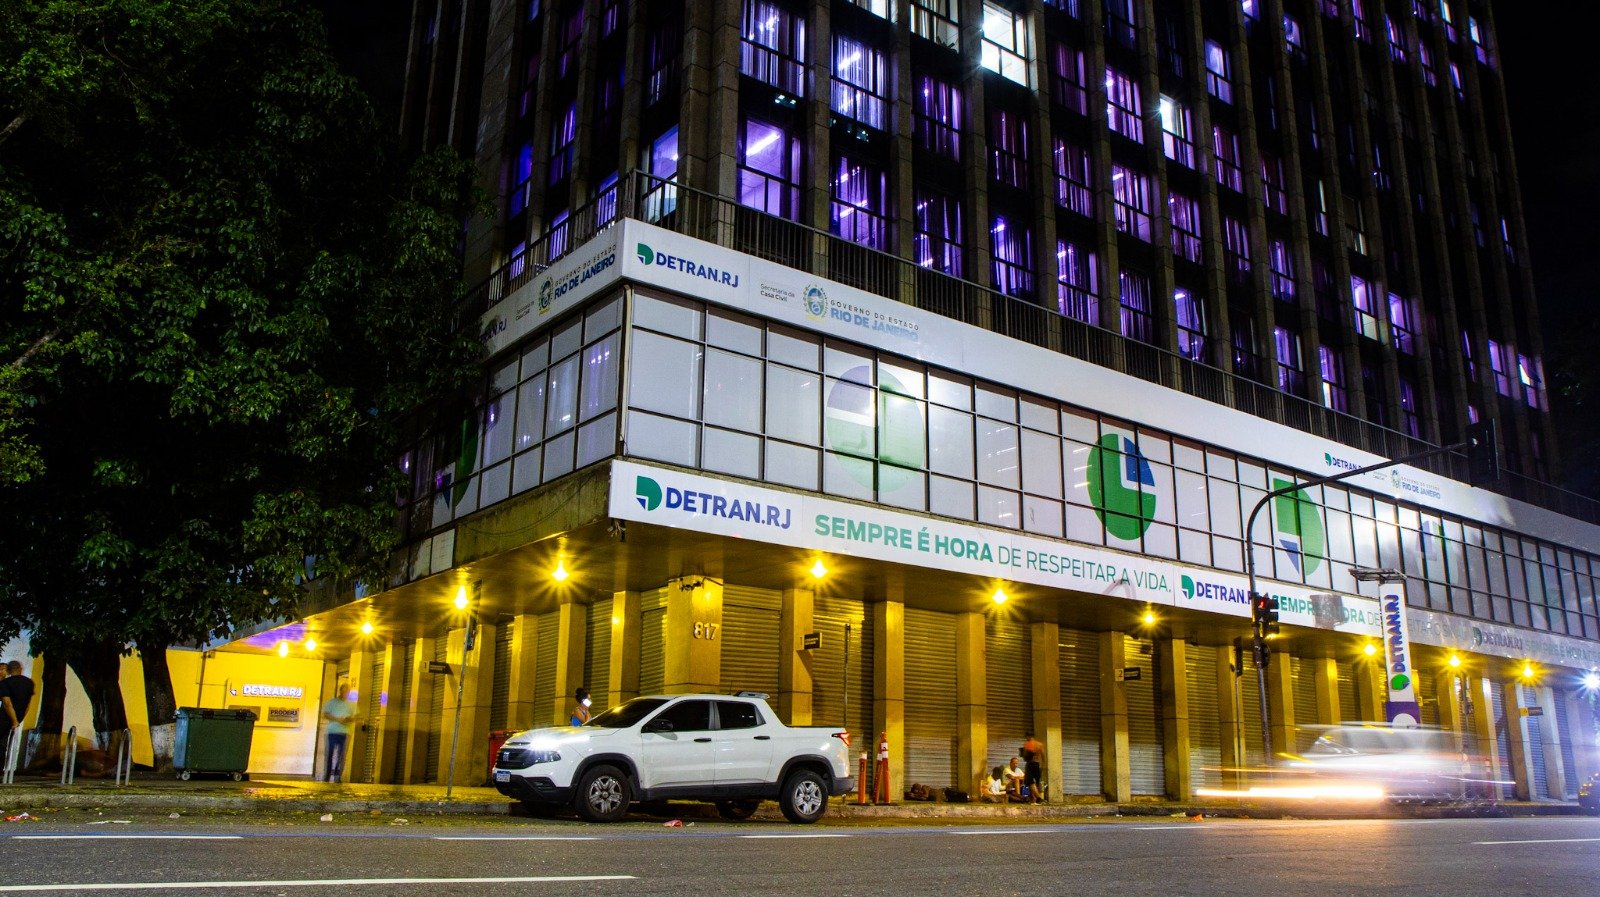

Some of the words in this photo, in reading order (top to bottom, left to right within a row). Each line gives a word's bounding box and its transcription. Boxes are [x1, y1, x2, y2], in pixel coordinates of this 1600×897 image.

[554, 285, 567, 299] RIO
[568, 276, 579, 290] DE
[581, 254, 615, 282] JANEIRO
[656, 252, 739, 288] DETRAN.RJ
[760, 290, 774, 298] Casa
[830, 300, 870, 316] GOVERNO
[874, 312, 884, 321] DO
[888, 316, 919, 331] ESTADO
[830, 307, 852, 322] RIO
[854, 313, 870, 329] DE
[872, 320, 918, 342] JANEIRO
[666, 487, 791, 529] DETRAN.RJ
[815, 514, 912, 550] SEMPRE
[917, 527, 930, 552] É
[934, 534, 993, 562] HORA
[998, 545, 1021, 567] DE
[1026, 551, 1116, 583] RESPEITAR
[1120, 568, 1131, 585] A
[1134, 569, 1172, 592] VIDA.
[694, 622, 719, 640] 817
[1384, 594, 1406, 673] DETRAN.RJ
